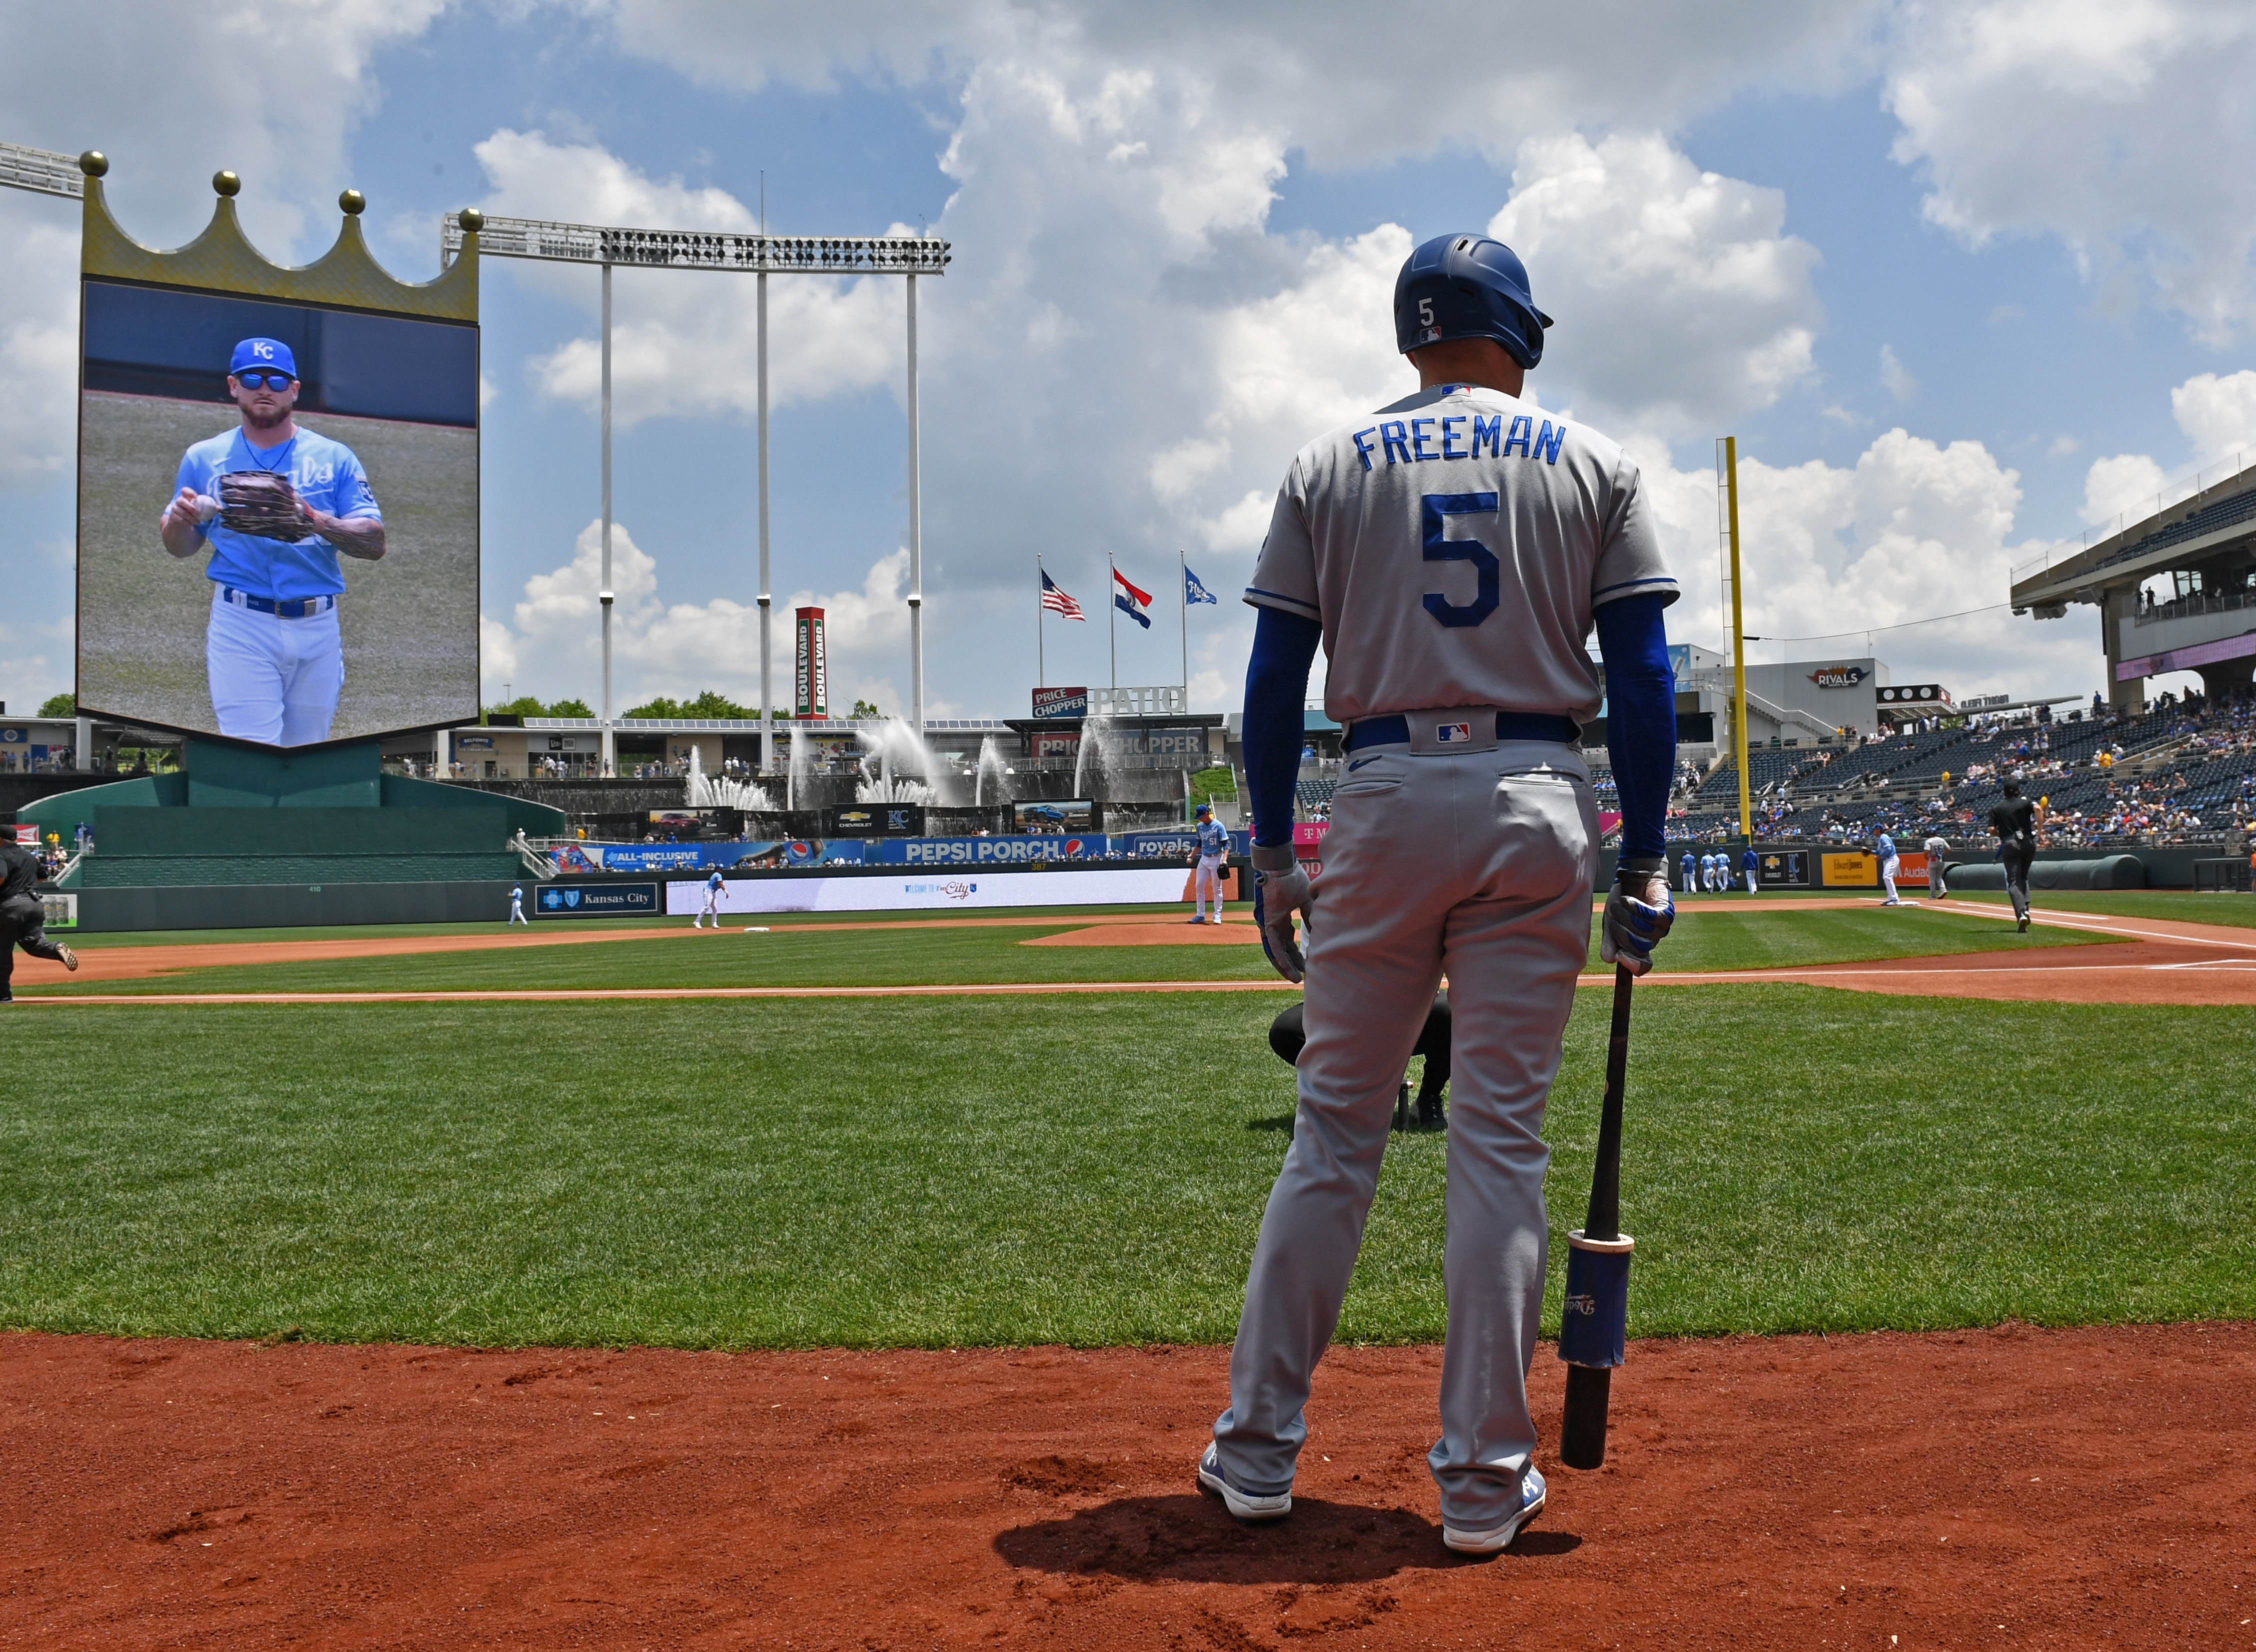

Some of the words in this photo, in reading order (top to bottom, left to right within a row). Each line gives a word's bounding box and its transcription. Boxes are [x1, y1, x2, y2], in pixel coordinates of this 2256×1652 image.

[1419, 298, 1434, 326] 5
[253, 342, 274, 360] KC
[1352, 415, 1566, 470] FREEMAN
[1422, 492, 1500, 627] 5
[798, 626, 808, 706] BOULEVARD
[816, 626, 825, 707] BOULEVARD
[1818, 673, 1858, 685] RIVALS
[1036, 688, 1067, 704] PRICE
[1094, 686, 1187, 714] PATIO
[1034, 697, 1086, 717] CHOPPER
[1038, 740, 1082, 756] PRIC
[1120, 736, 1199, 754] HOPPER
[906, 842, 972, 861] PEPSI
[978, 840, 1059, 860] PORCH
[1210, 838, 1217, 846] 51
[617, 852, 698, 862] ALL-INCLUSIVE
[1031, 863, 1046, 871] 387
[1904, 866, 1929, 878] Audac
[584, 894, 624, 904] Kansas
[627, 892, 649, 904] City
[946, 882, 969, 900] City
